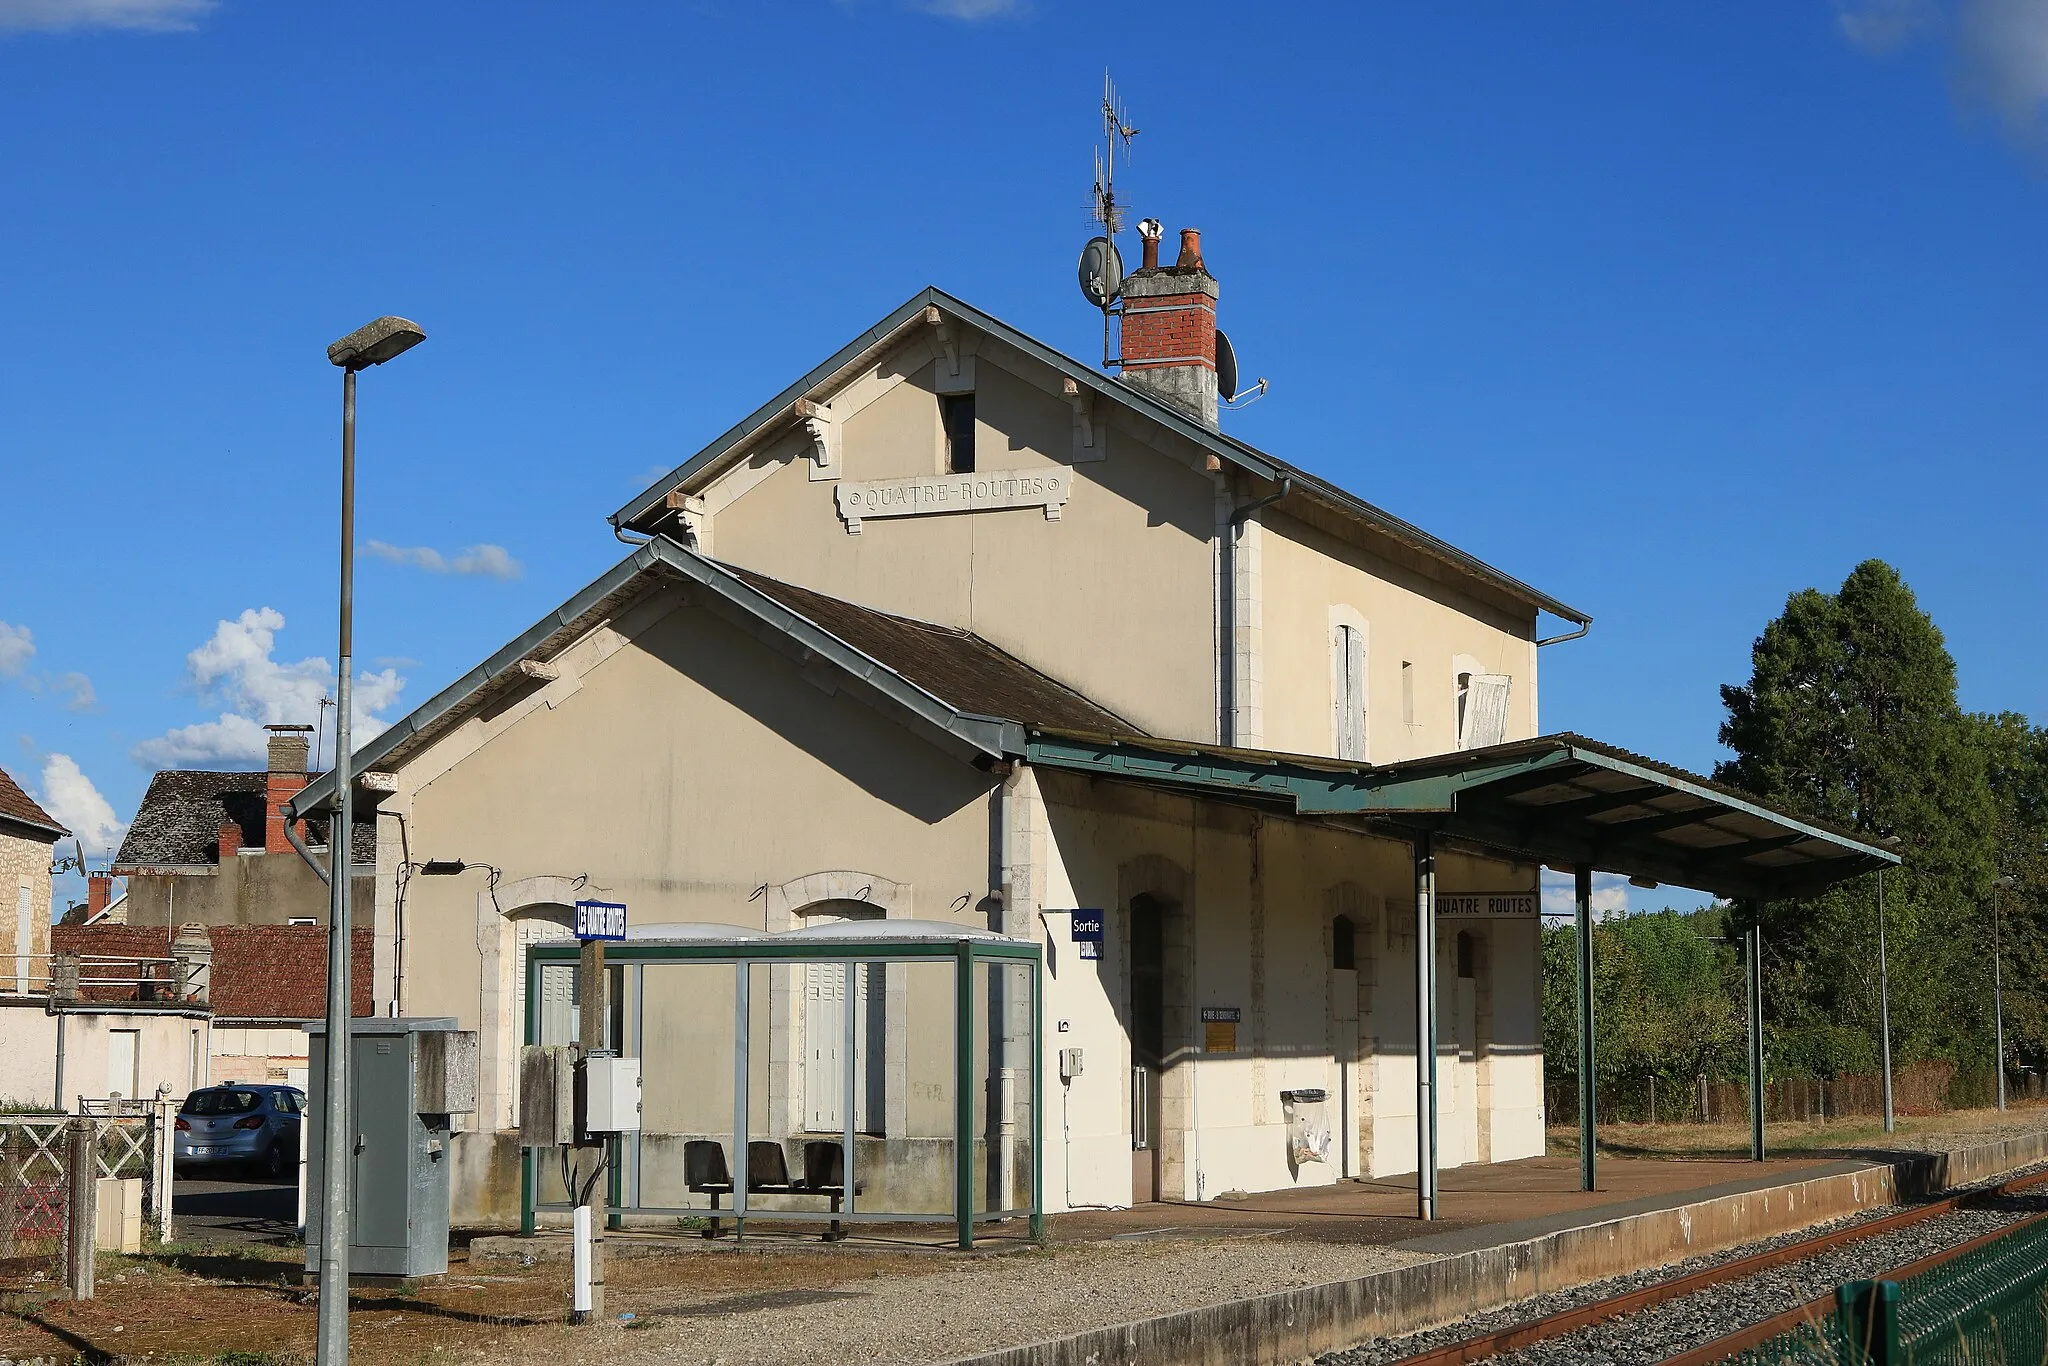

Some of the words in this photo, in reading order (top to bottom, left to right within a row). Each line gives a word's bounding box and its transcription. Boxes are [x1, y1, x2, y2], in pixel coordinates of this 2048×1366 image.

[866, 477, 1043, 511] QUATRE-ROUTES
[1436, 898, 1479, 914] QUATRE
[1488, 898, 1532, 913] ROUTES
[577, 906, 587, 934] LES
[1073, 919, 1100, 932] Sortie
